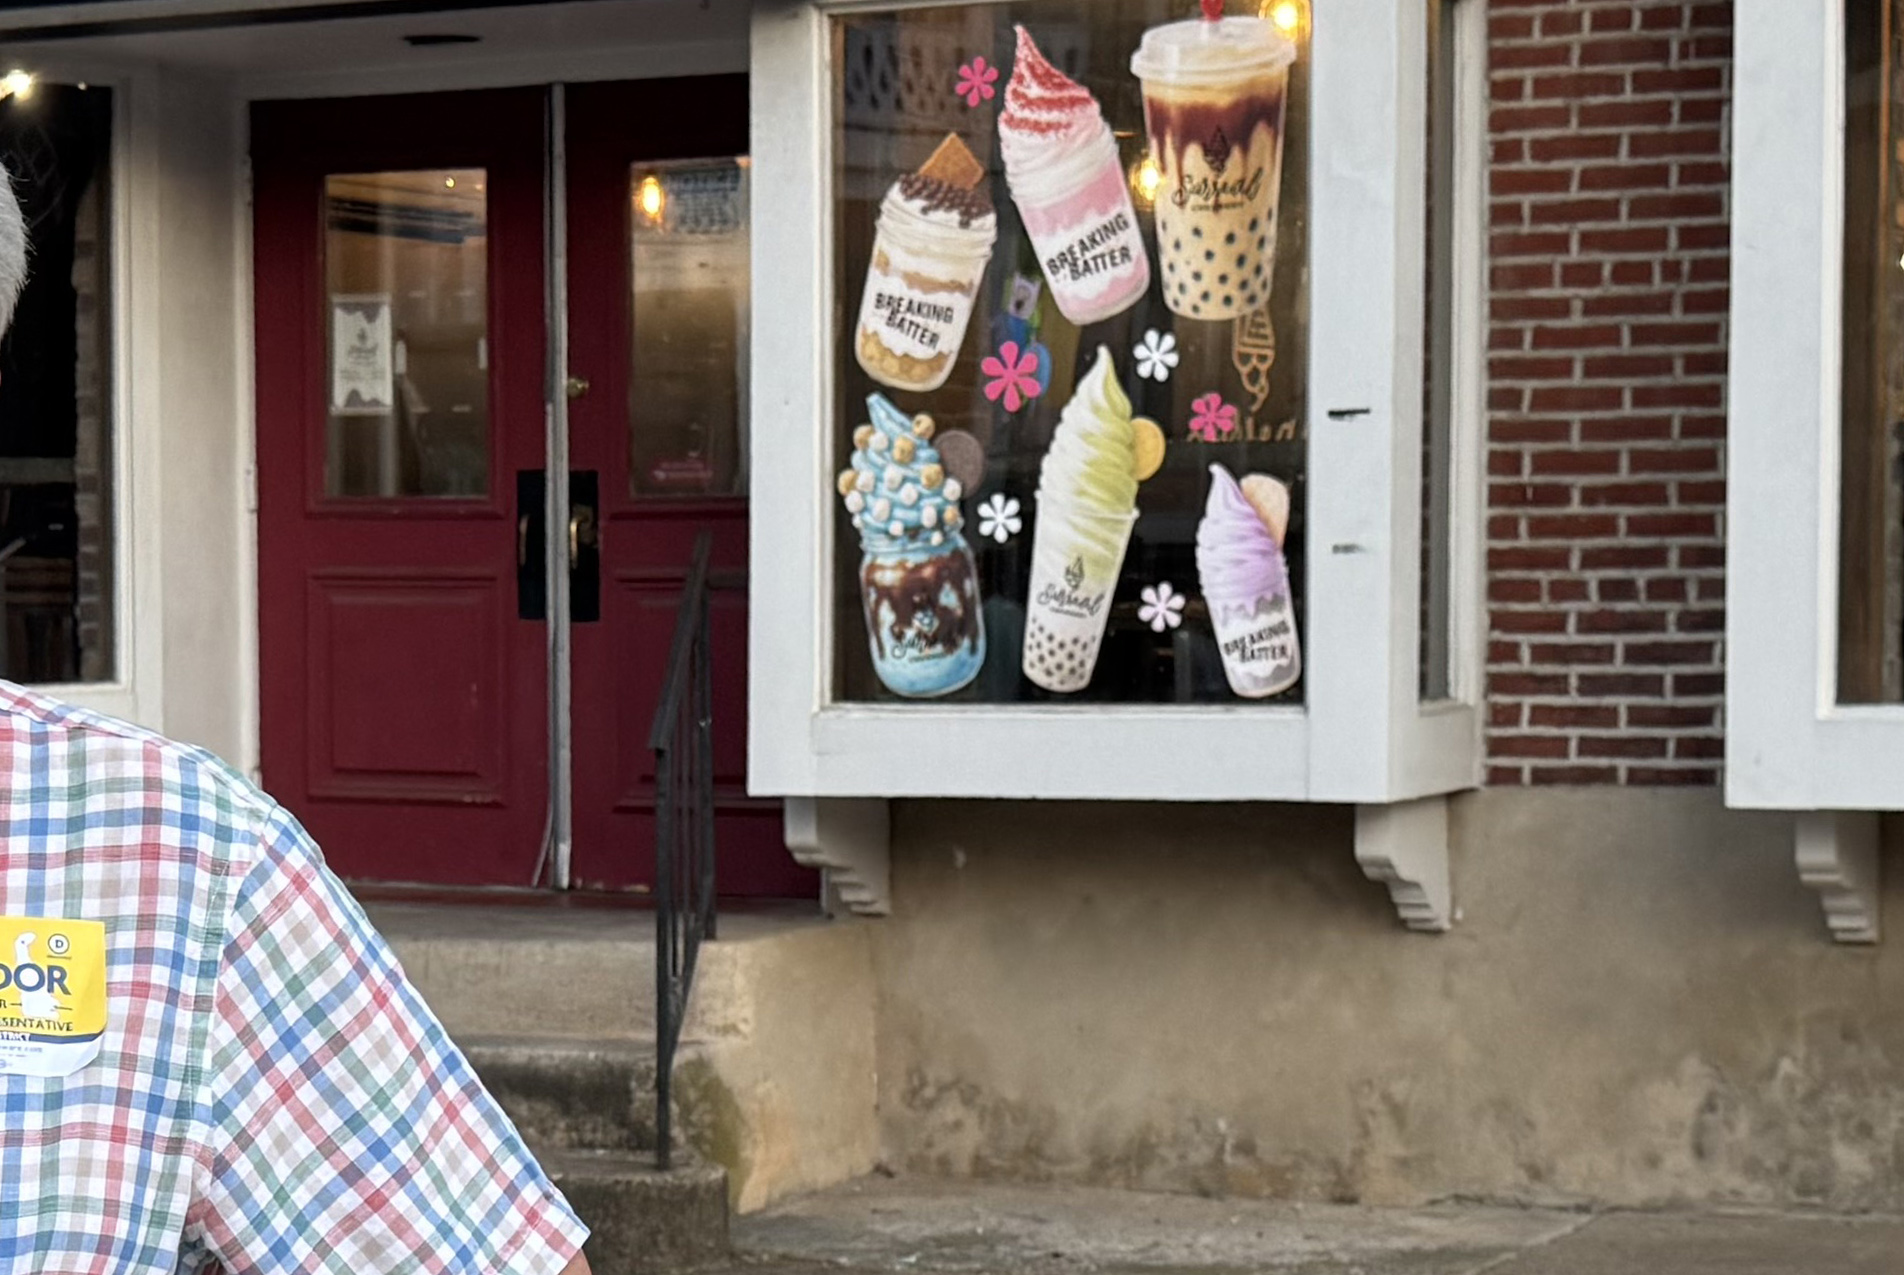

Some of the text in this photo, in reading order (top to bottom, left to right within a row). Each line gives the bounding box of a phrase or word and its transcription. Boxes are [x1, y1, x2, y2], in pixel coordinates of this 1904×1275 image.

[1047, 213, 1130, 276] BREAKING
[1069, 246, 1132, 281] BATTER
[874, 292, 954, 324] BREAKING
